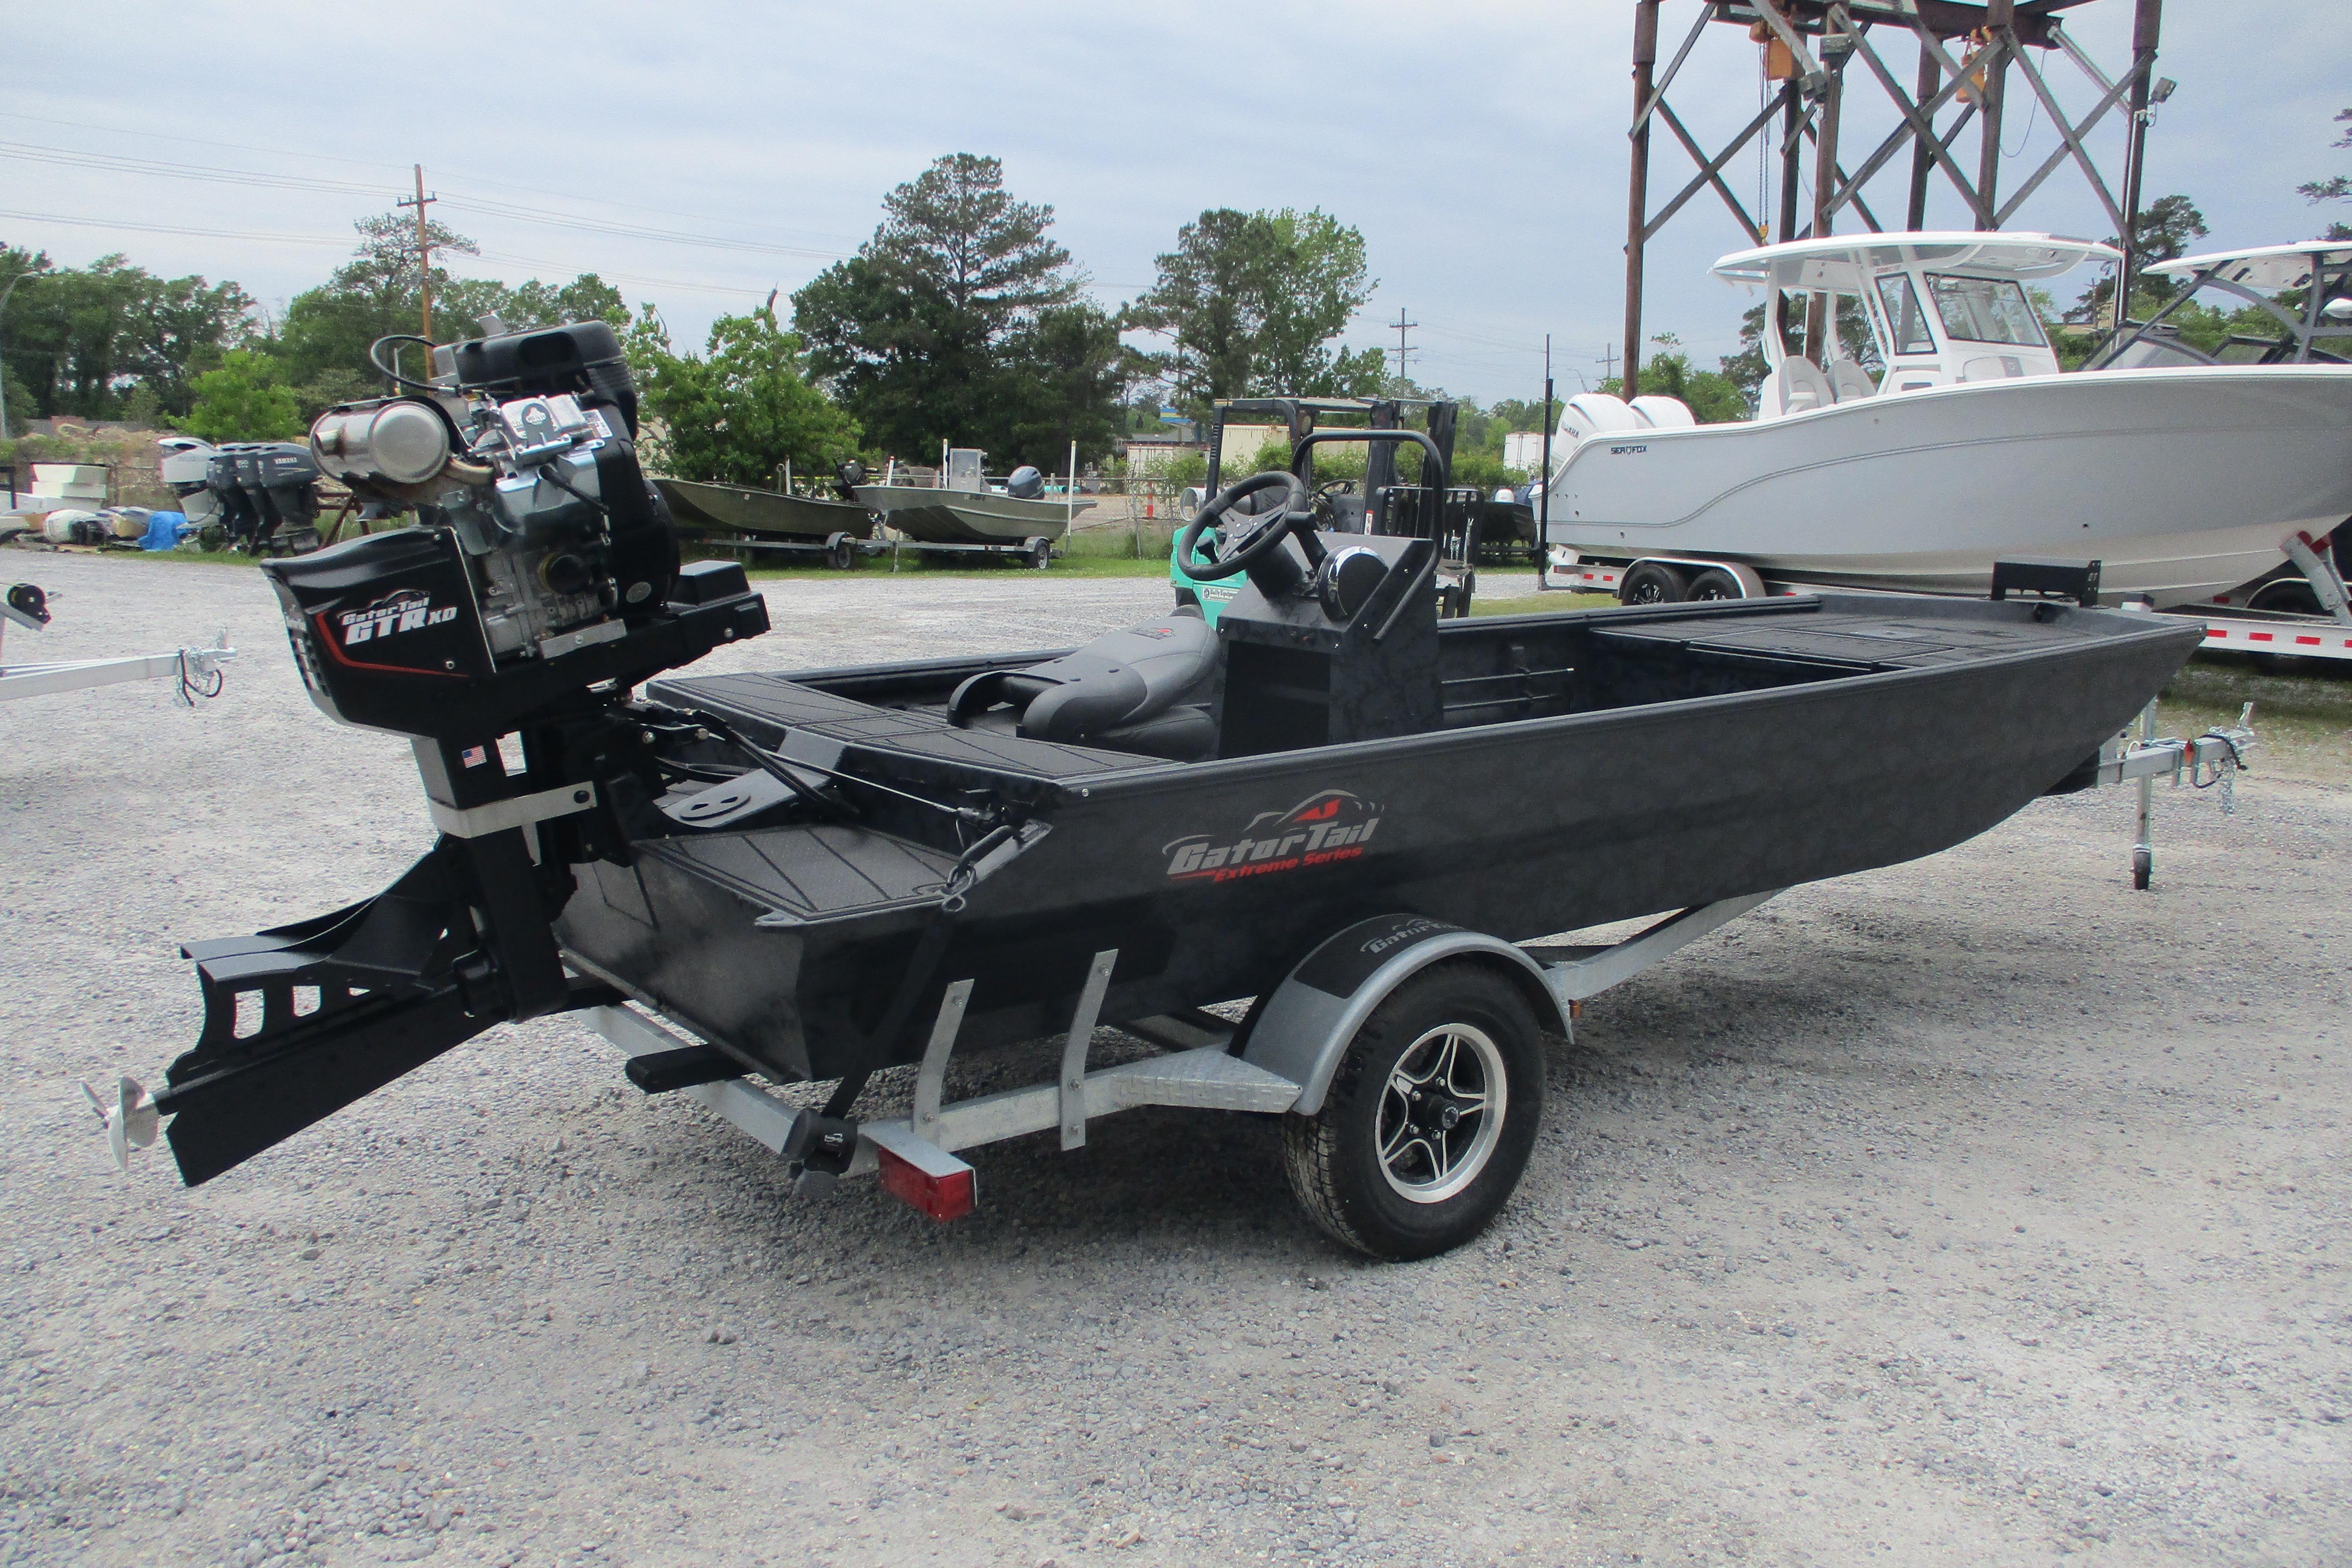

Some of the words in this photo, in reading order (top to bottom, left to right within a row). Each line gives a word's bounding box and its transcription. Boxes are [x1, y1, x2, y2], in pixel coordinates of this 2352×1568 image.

[345, 607, 427, 645] GTR
[1213, 858, 1298, 882] Extreme
[1302, 847, 1363, 866] Series
